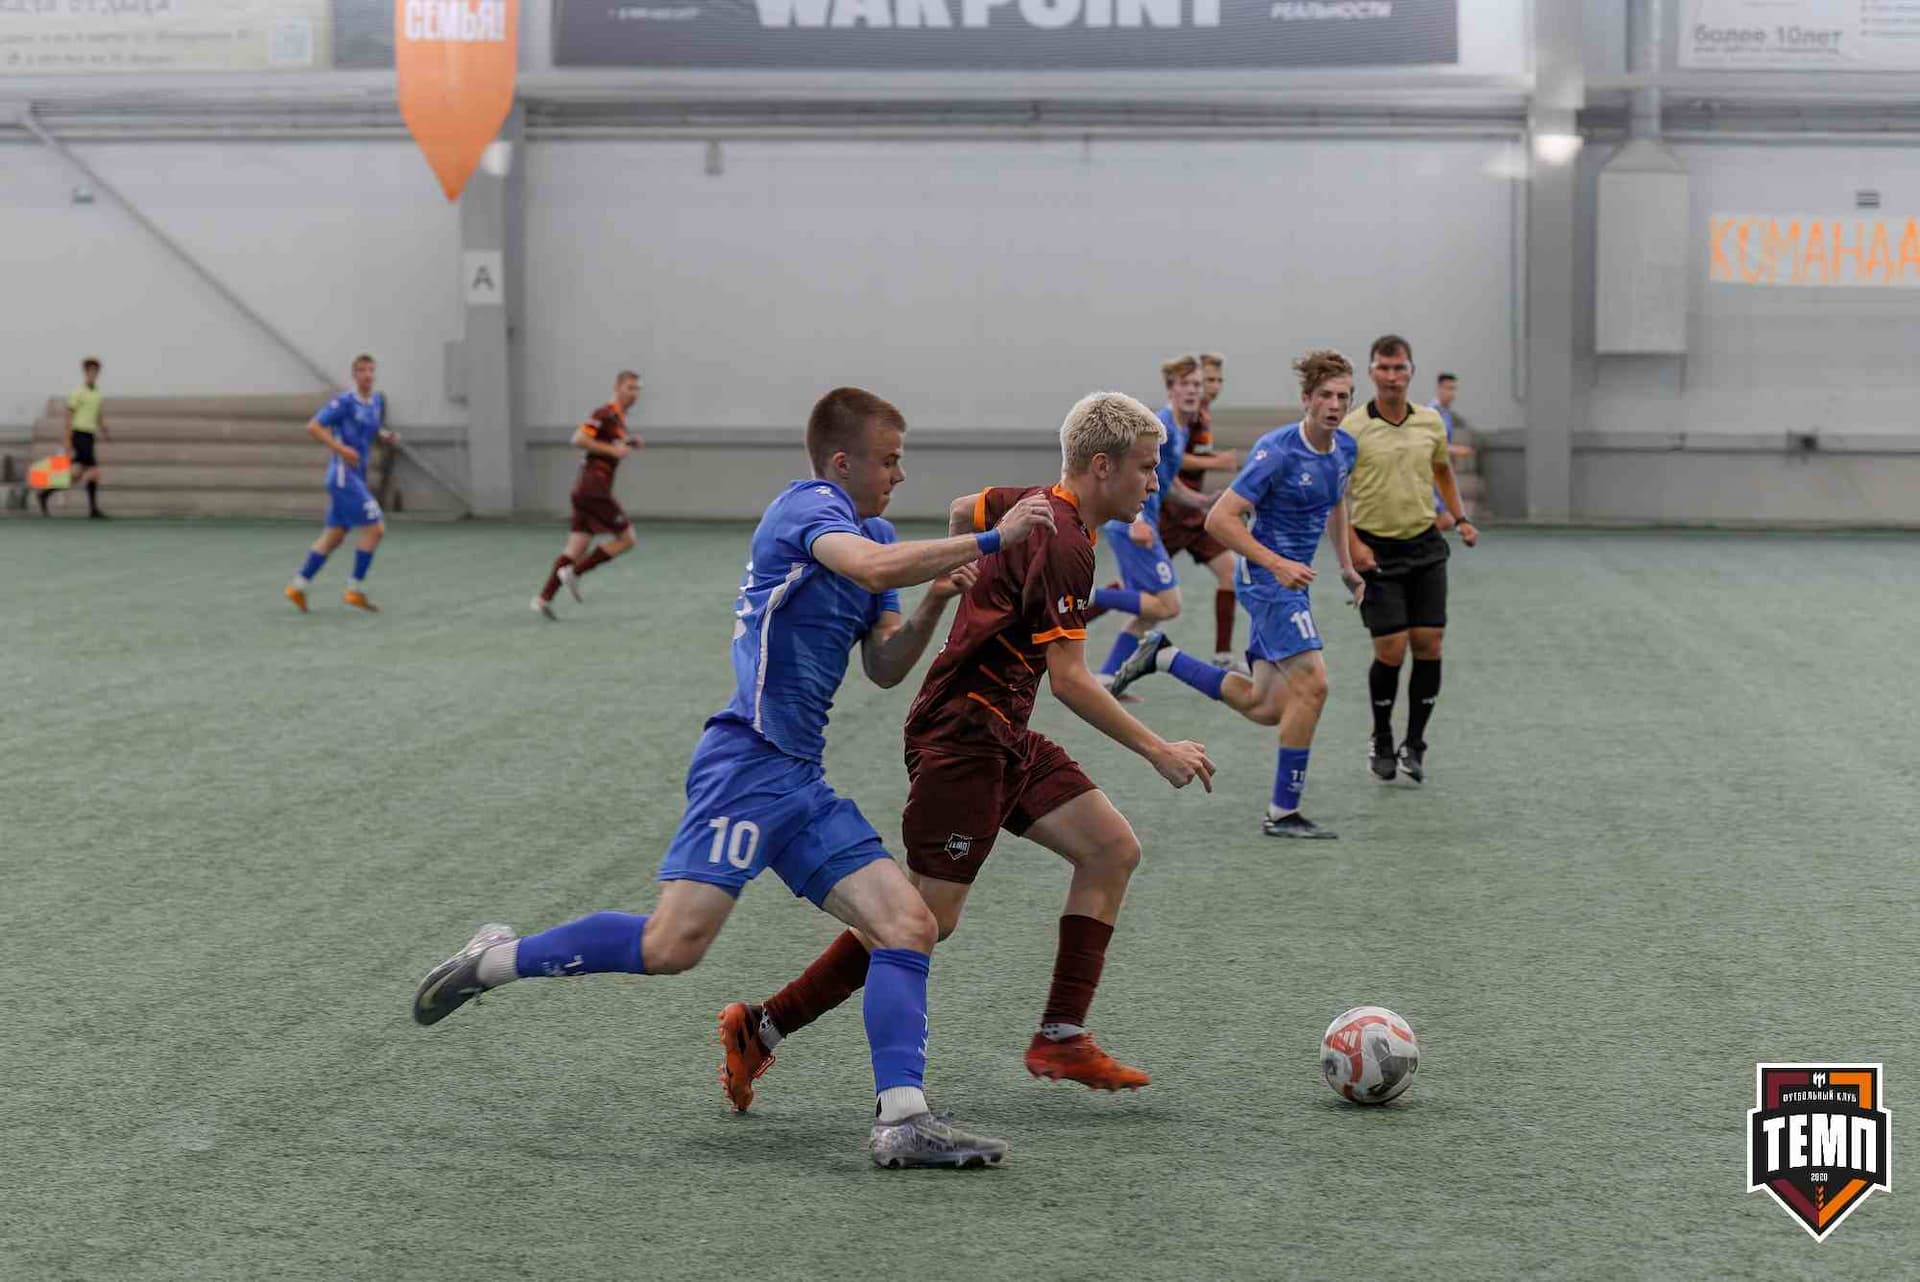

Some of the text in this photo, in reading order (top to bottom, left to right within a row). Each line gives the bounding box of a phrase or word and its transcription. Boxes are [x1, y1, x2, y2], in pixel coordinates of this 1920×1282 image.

[404, 0, 506, 42] СЕМЬЯ!
[1710, 214, 1920, 285] КОМАНДА
[1156, 561, 1173, 584] 9
[1290, 610, 1317, 640] 11
[708, 816, 760, 870] 10
